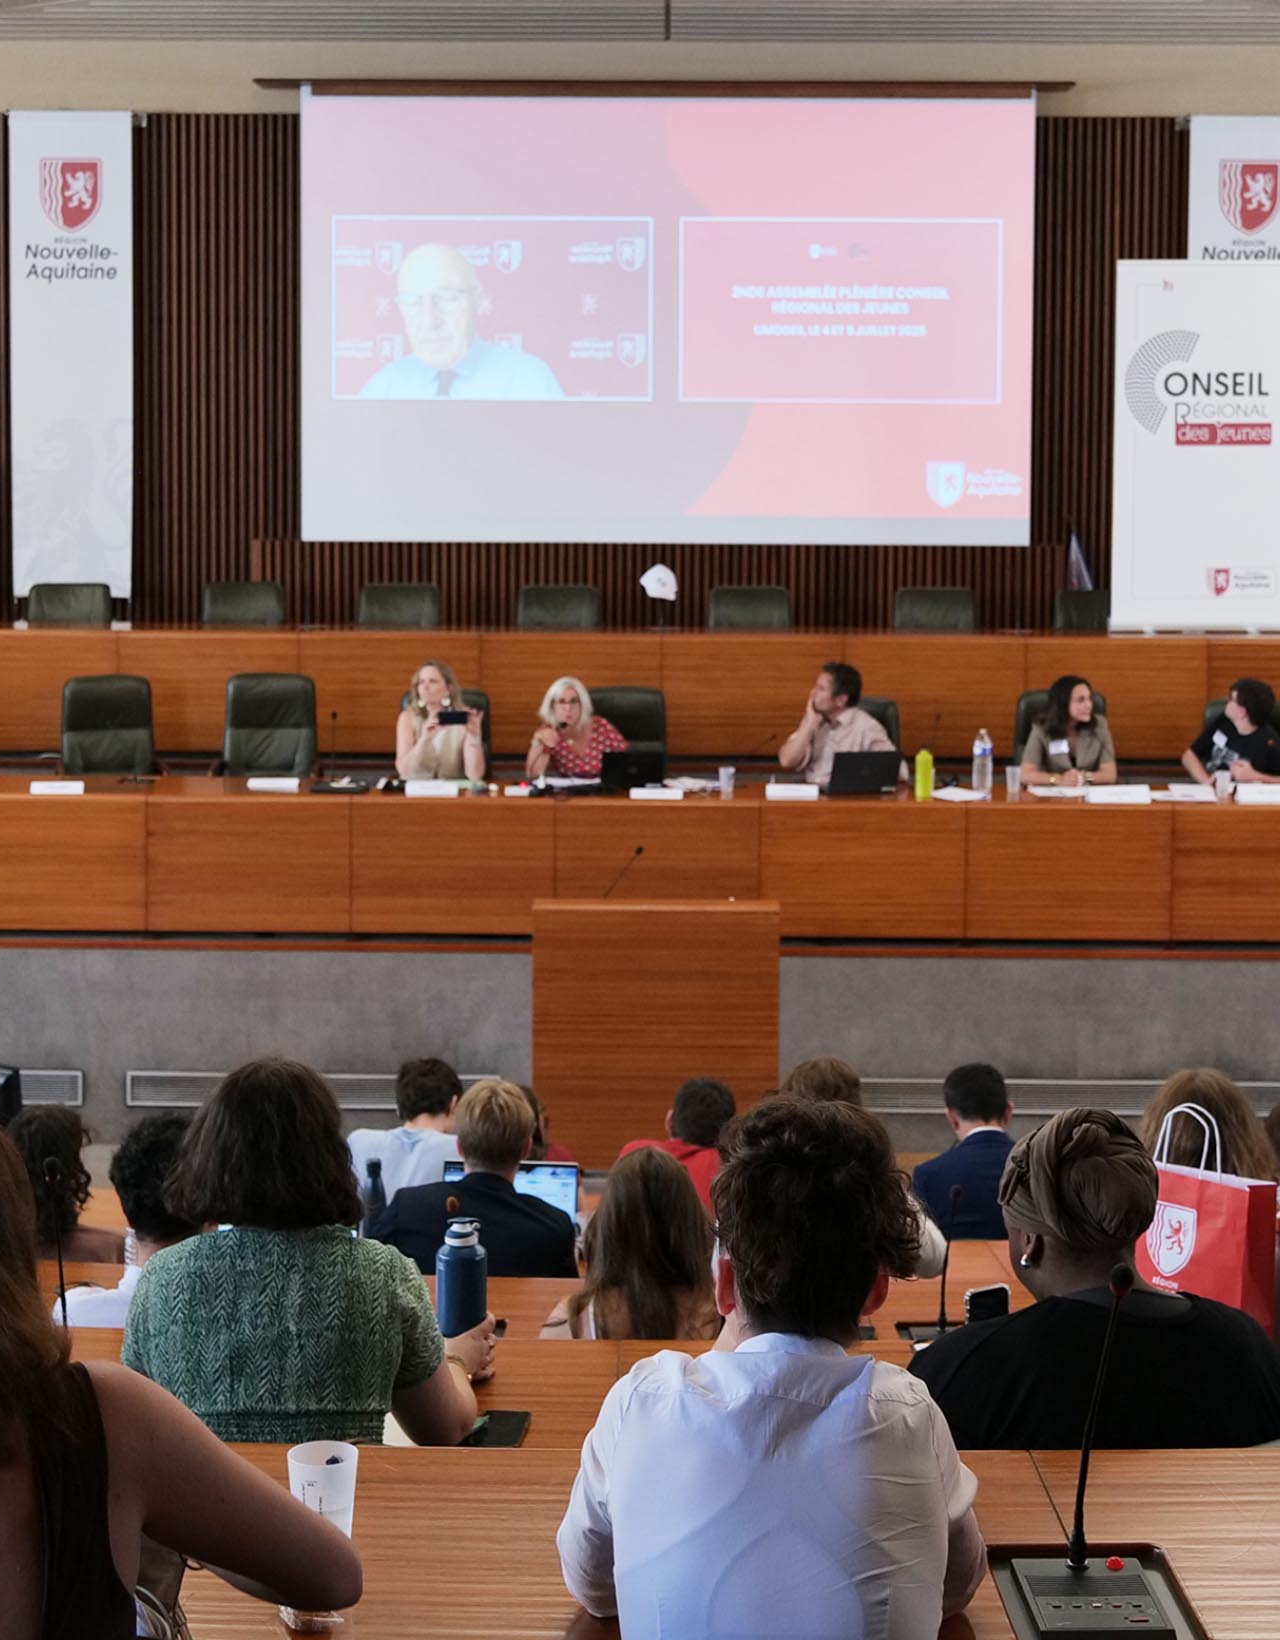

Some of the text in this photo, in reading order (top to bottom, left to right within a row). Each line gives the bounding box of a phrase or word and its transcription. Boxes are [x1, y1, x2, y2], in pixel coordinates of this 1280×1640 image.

[25, 244, 119, 260] Nouvelle-
[26, 262, 118, 285] Aquitaine
[1175, 402, 1269, 426] RÉGIONAL
[1178, 420, 1271, 445] des jeunes
[1152, 1276, 1179, 1289] RÉGION
